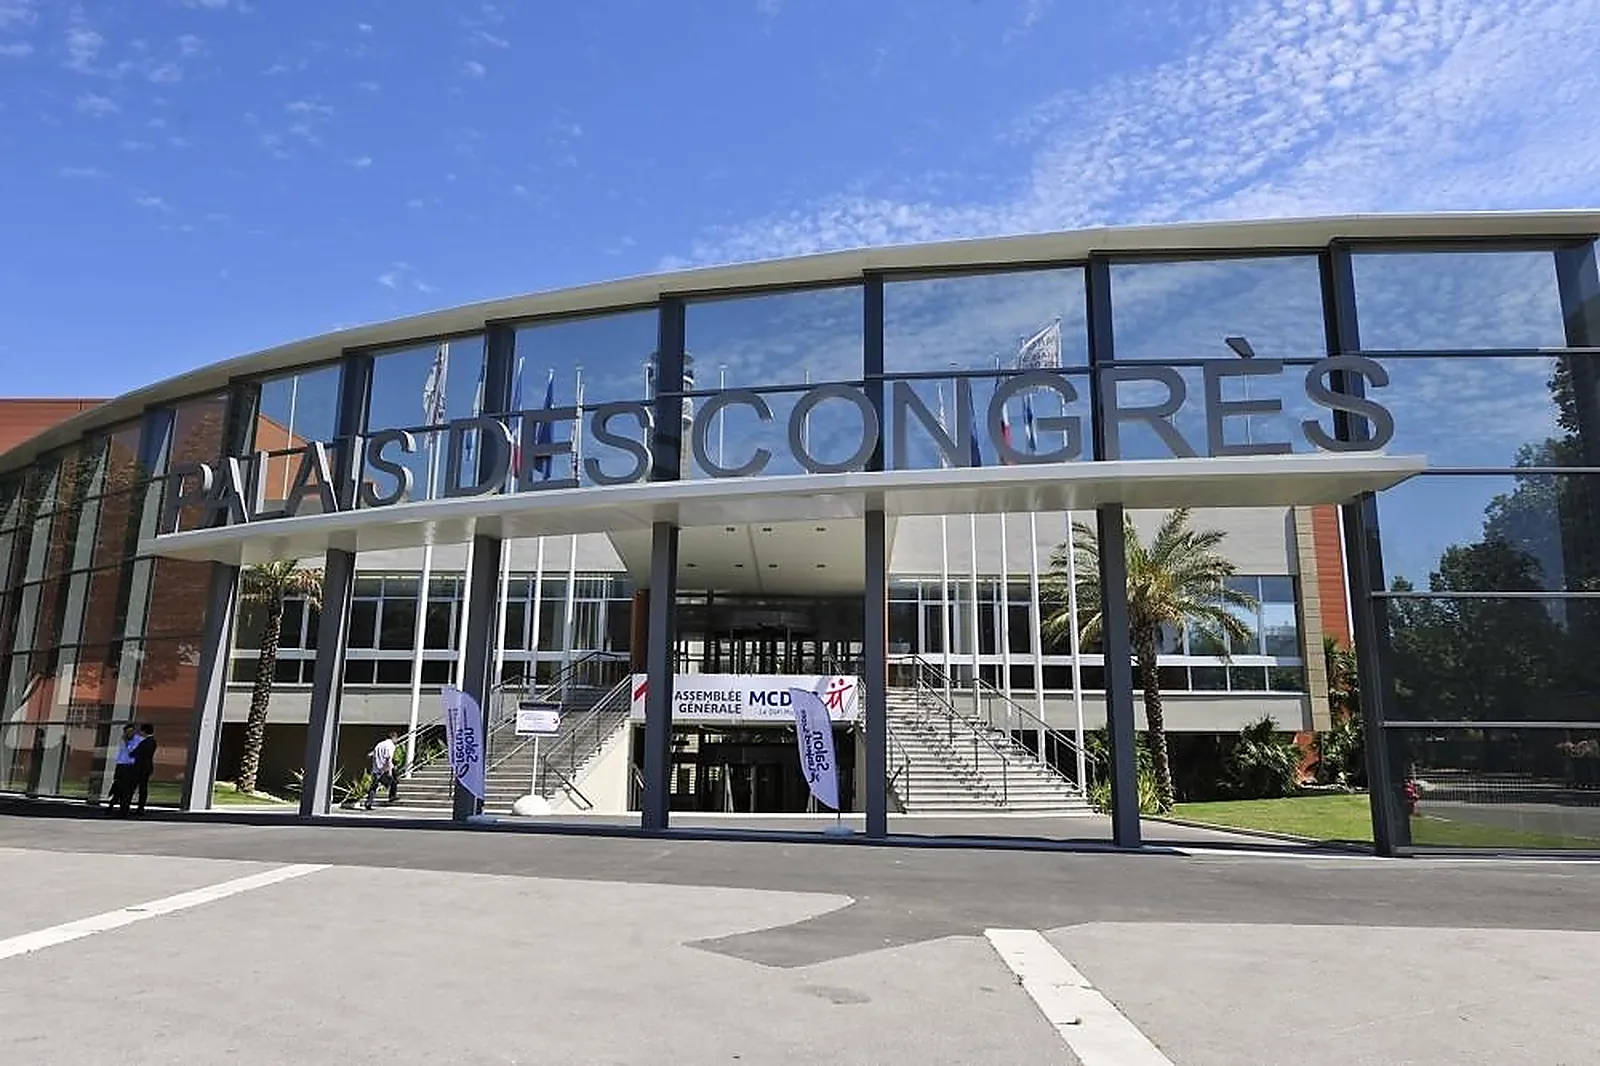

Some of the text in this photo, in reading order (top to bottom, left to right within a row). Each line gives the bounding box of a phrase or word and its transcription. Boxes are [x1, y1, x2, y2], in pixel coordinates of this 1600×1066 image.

[157, 336, 1395, 535] PALAIS DES CONGRÈS
[674, 690, 742, 702] ASSEMBLÉE
[678, 702, 742, 715] GÉNÉRALE
